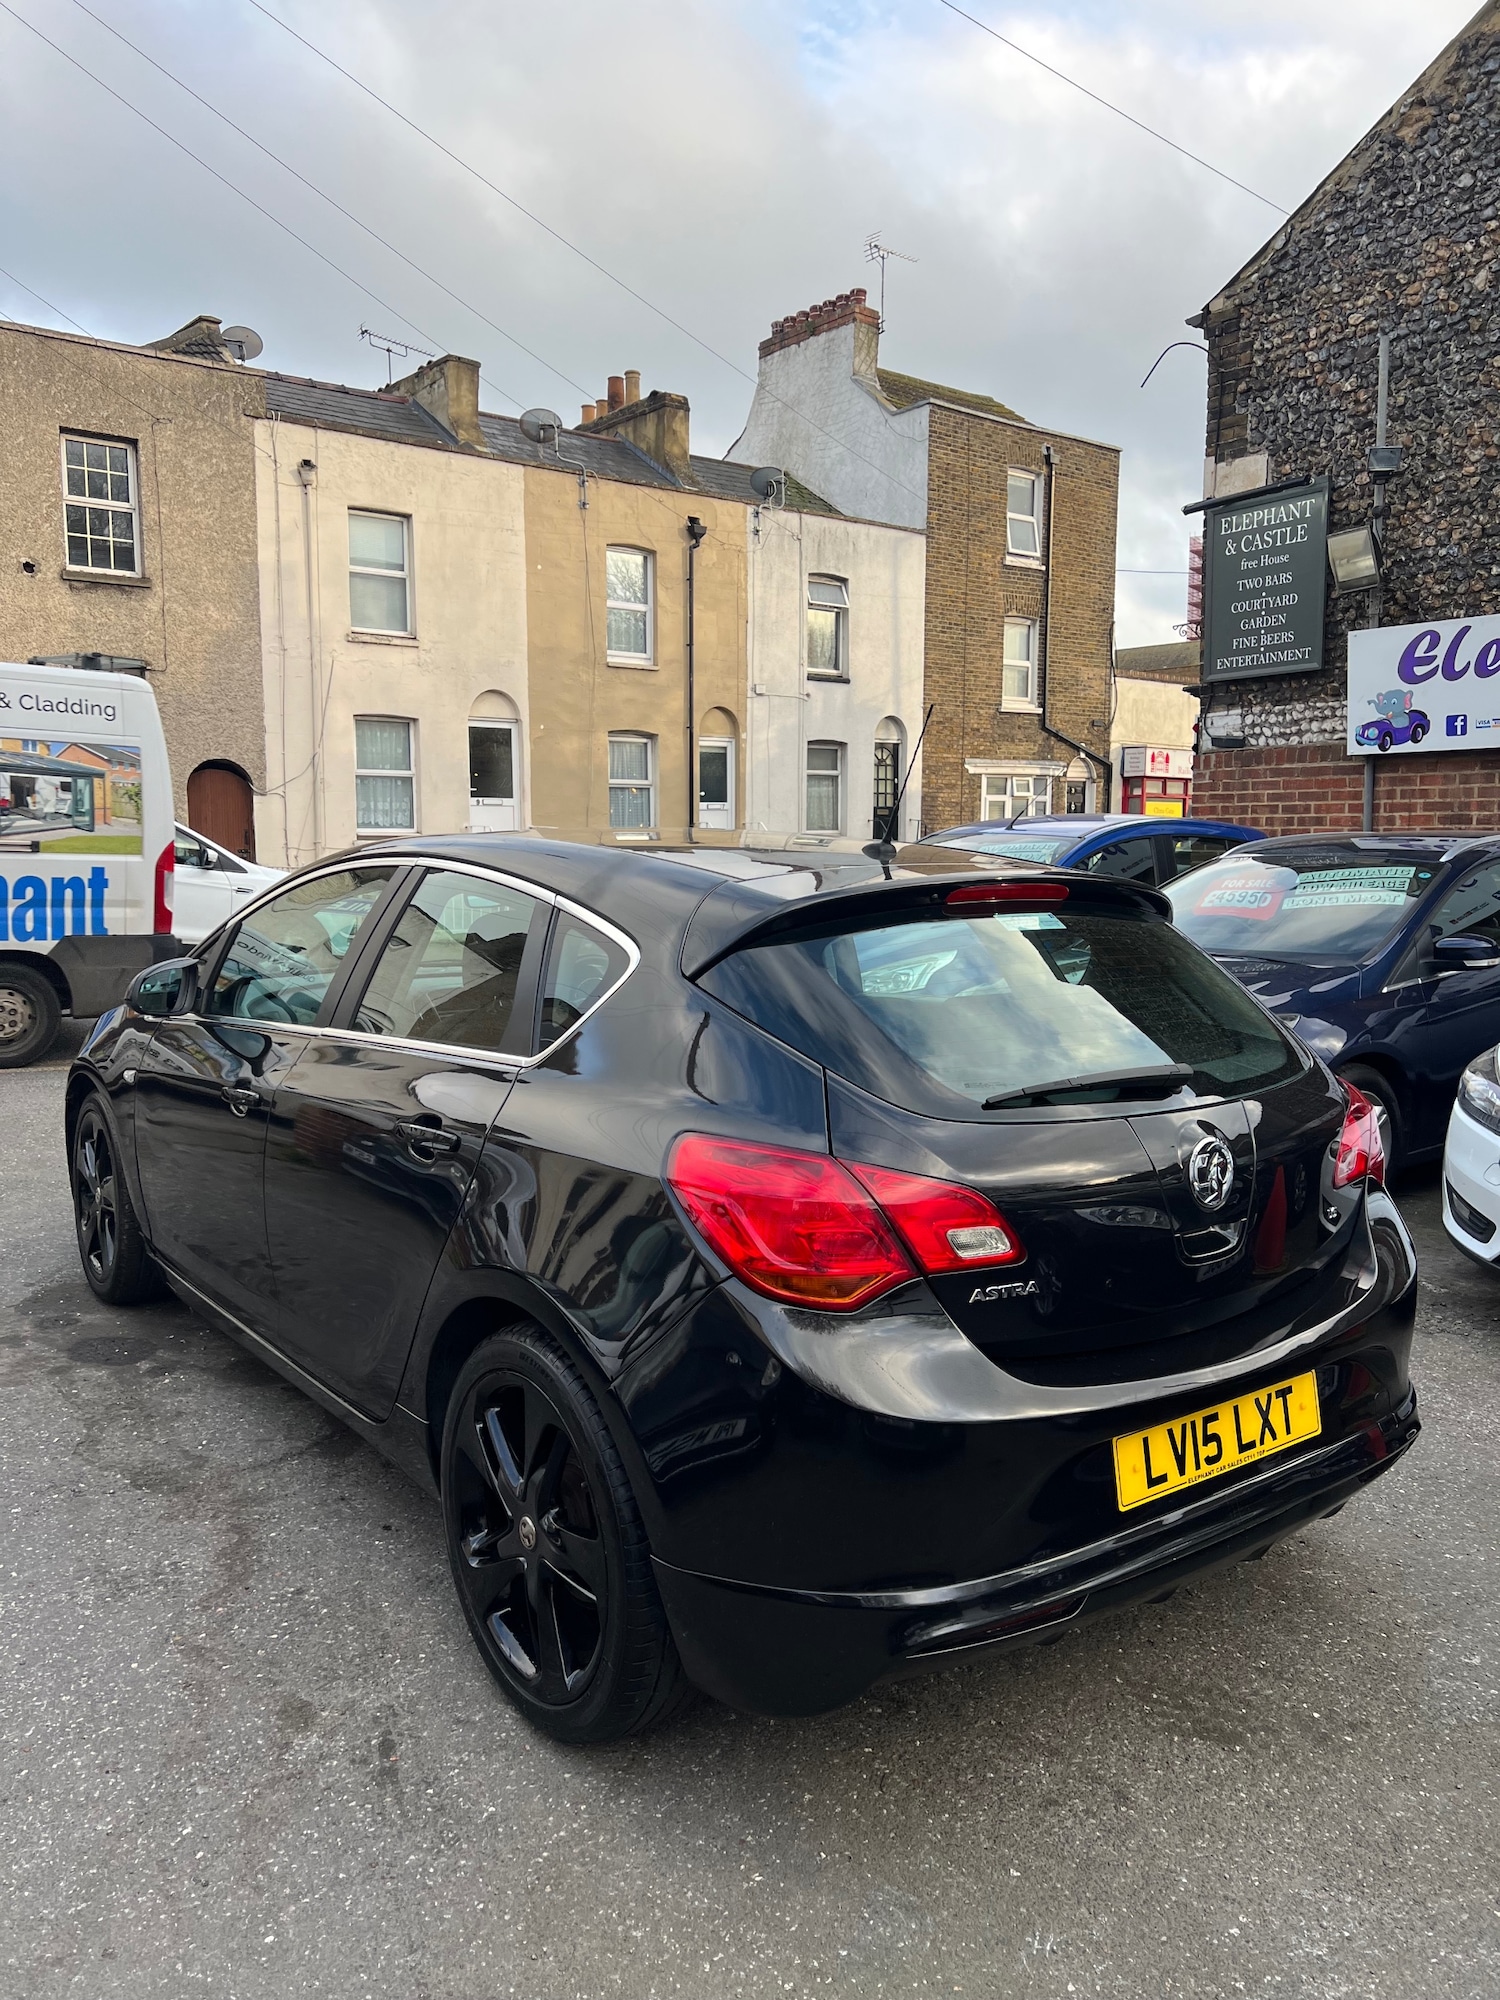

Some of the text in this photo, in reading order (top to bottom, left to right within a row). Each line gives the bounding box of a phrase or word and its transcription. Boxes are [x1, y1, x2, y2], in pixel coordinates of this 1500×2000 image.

[1220, 499, 1316, 536] ELEPHANT
[1225, 523, 1308, 556] & CASTLE
[1240, 553, 1290, 571] free House
[1237, 571, 1293, 591] TWO BARS
[1231, 592, 1299, 614] COURTYARD
[1240, 613, 1287, 630] GARDEN
[1232, 630, 1294, 650] FINE BEERS
[1216, 646, 1312, 670] ENTERTAINMENT
[18, 694, 117, 722] Cladding
[1221, 879, 1274, 888] FOR SALE
[1303, 868, 1411, 881] AUTOMATIC
[1300, 879, 1407, 893] LOW MILEAGE
[0, 866, 109, 943] ant
[1289, 895, 1339, 906] LONG
[968, 1280, 1040, 1304] ASTRA
[1142, 1385, 1293, 1490] LV15 LXT
[1187, 1469, 1215, 1484] ELEPHANT
[1215, 1463, 1227, 1473] CAR
[1227, 1459, 1243, 1469] SALES
